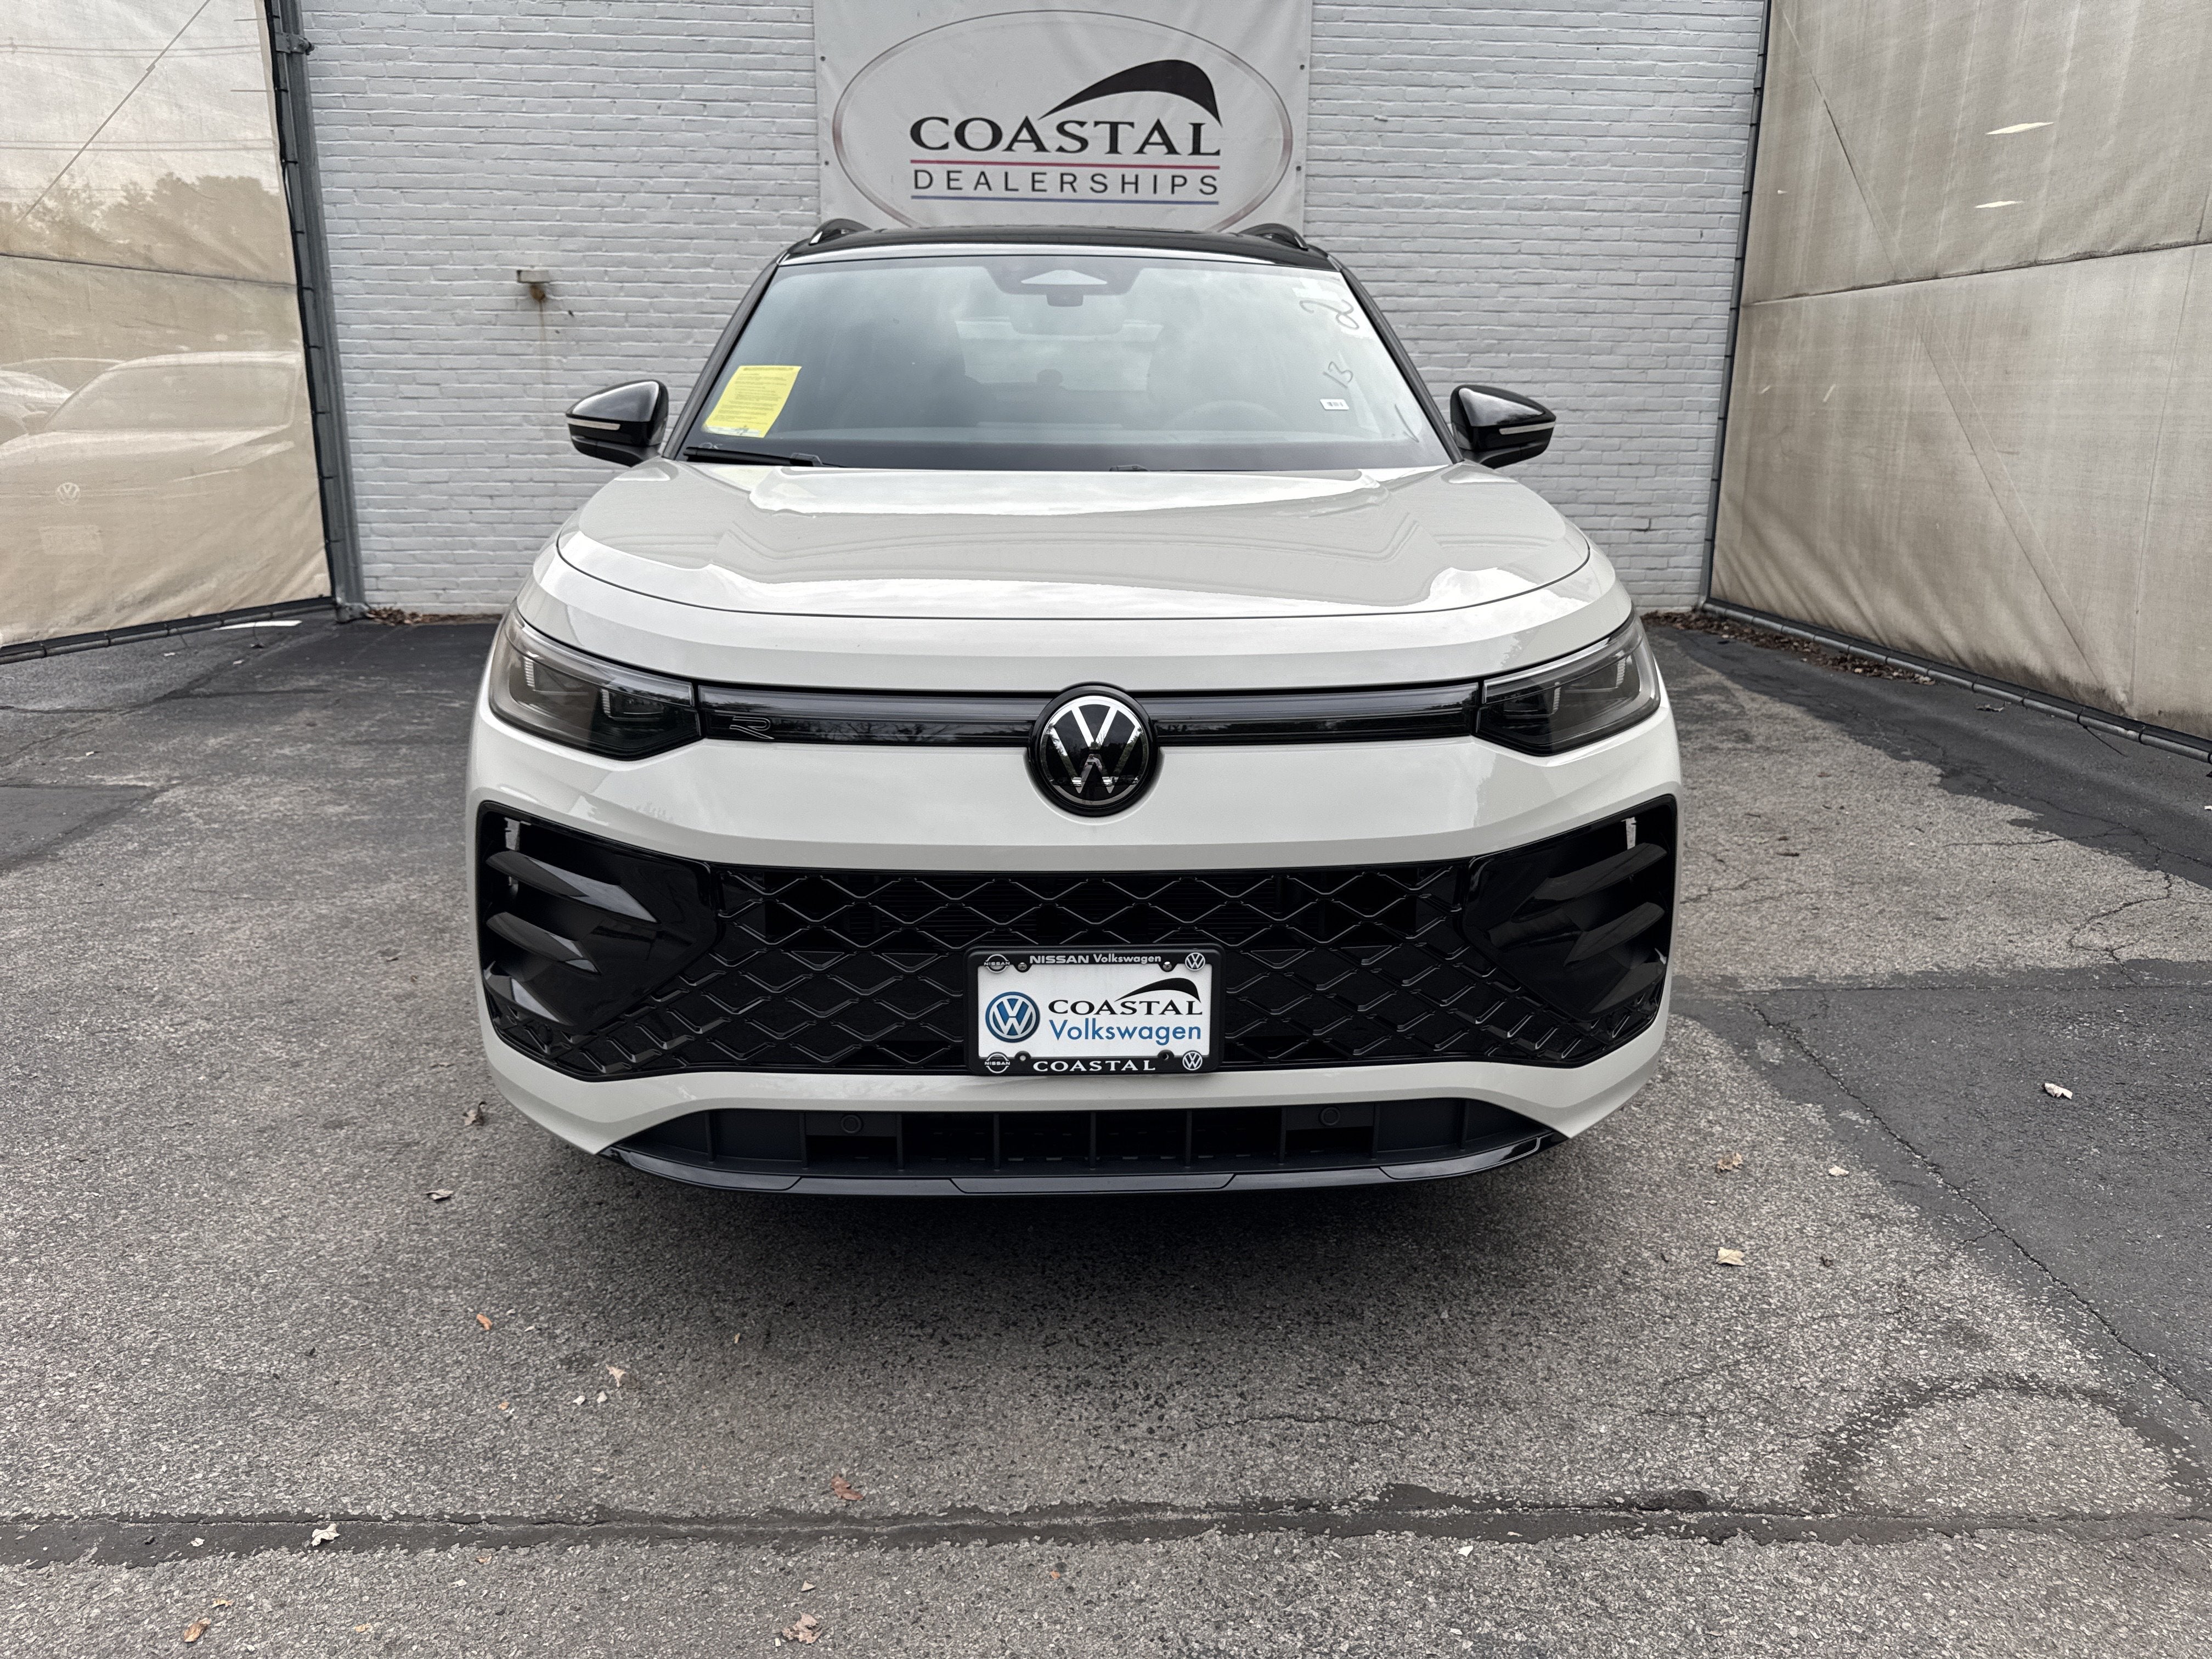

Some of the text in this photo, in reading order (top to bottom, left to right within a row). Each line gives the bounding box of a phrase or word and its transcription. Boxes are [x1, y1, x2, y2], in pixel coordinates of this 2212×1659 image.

[910, 115, 1221, 156] COASTAL
[913, 169, 1218, 195] DEALERSHIPS
[729, 715, 775, 740] R
[1030, 953, 1161, 964] NISSAN Volkswagen
[1048, 998, 1203, 1015] COASTAL
[1049, 1018, 1201, 1046] Volkswagen
[1033, 1059, 1156, 1072] COASTAL
